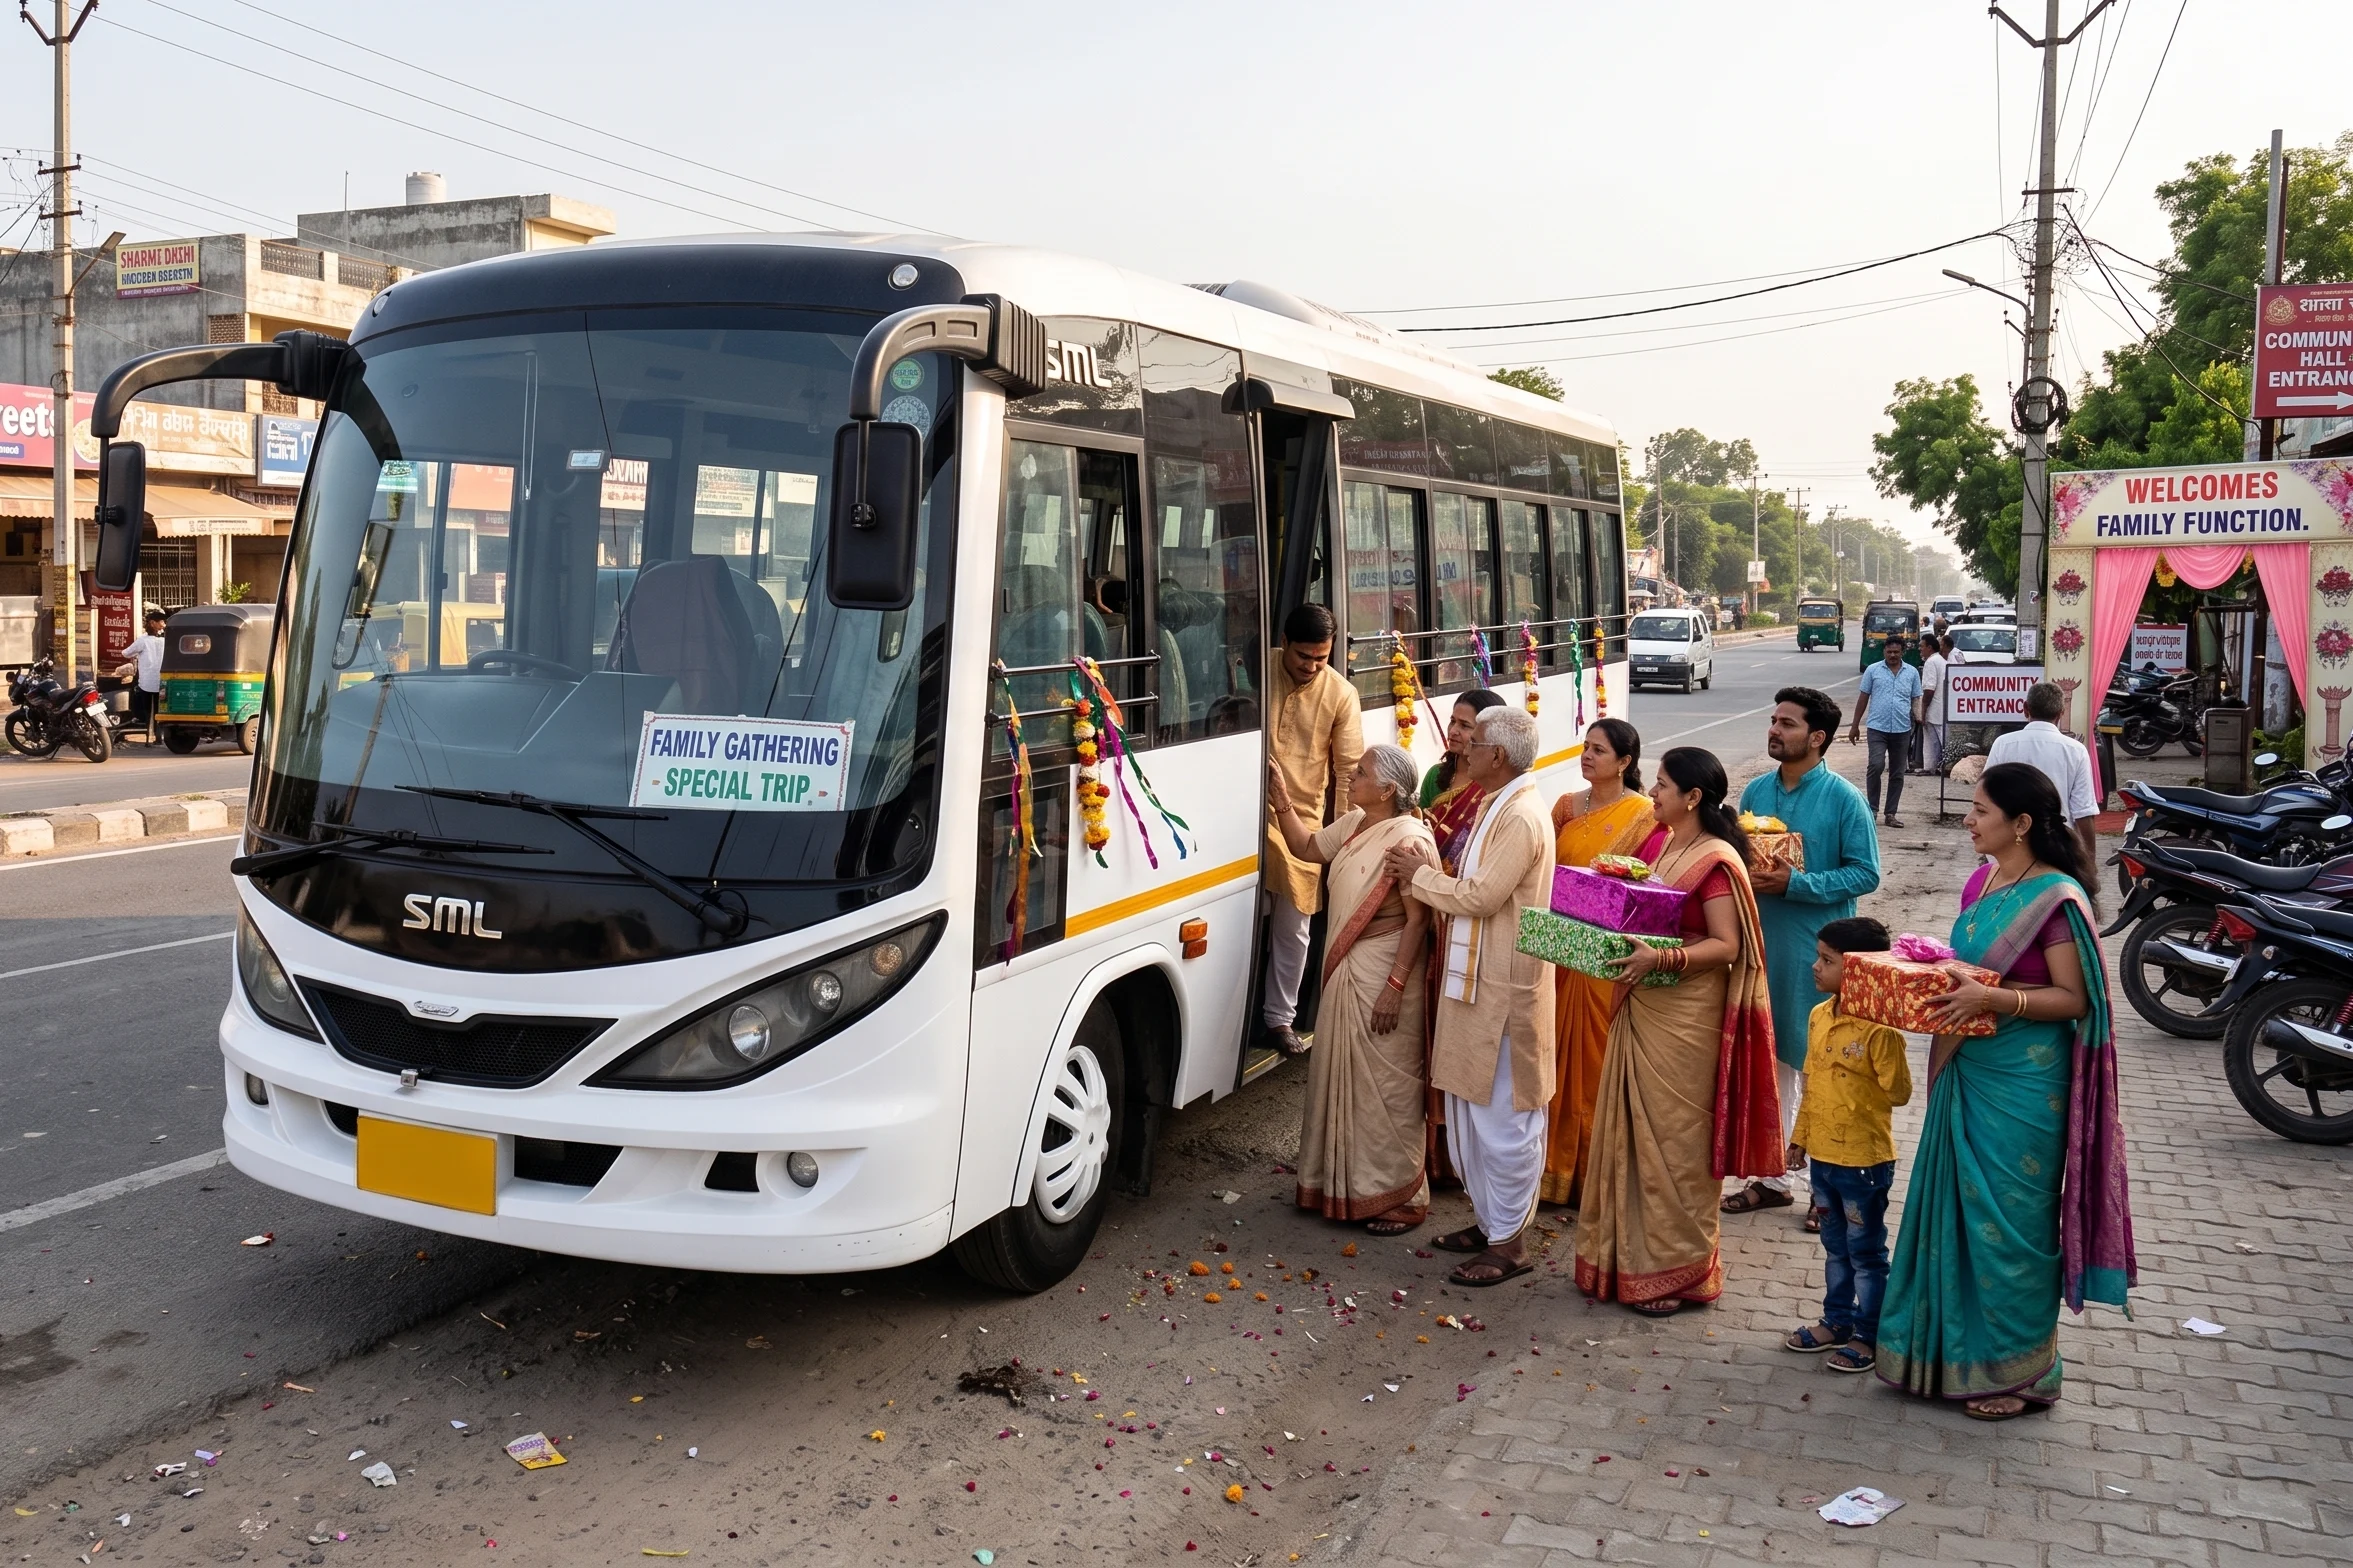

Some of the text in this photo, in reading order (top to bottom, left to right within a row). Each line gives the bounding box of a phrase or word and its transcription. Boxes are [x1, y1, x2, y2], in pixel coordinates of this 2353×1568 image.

[2264, 330, 2352, 349] COMMUN
[1047, 338, 1112, 389] SML
[2300, 350, 2346, 367] HALL
[2268, 369, 2353, 388] ENTRAN
[0, 402, 54, 438] eet
[2125, 471, 2279, 504] WELCOMES
[2097, 507, 2309, 537] FAMILY FUNCTION.
[1956, 698, 2025, 714] ENTRANC
[650, 729, 839, 767] FAMILY GATHERING
[664, 767, 811, 804] SPECIAL TRIP
[402, 893, 503, 940] SML
